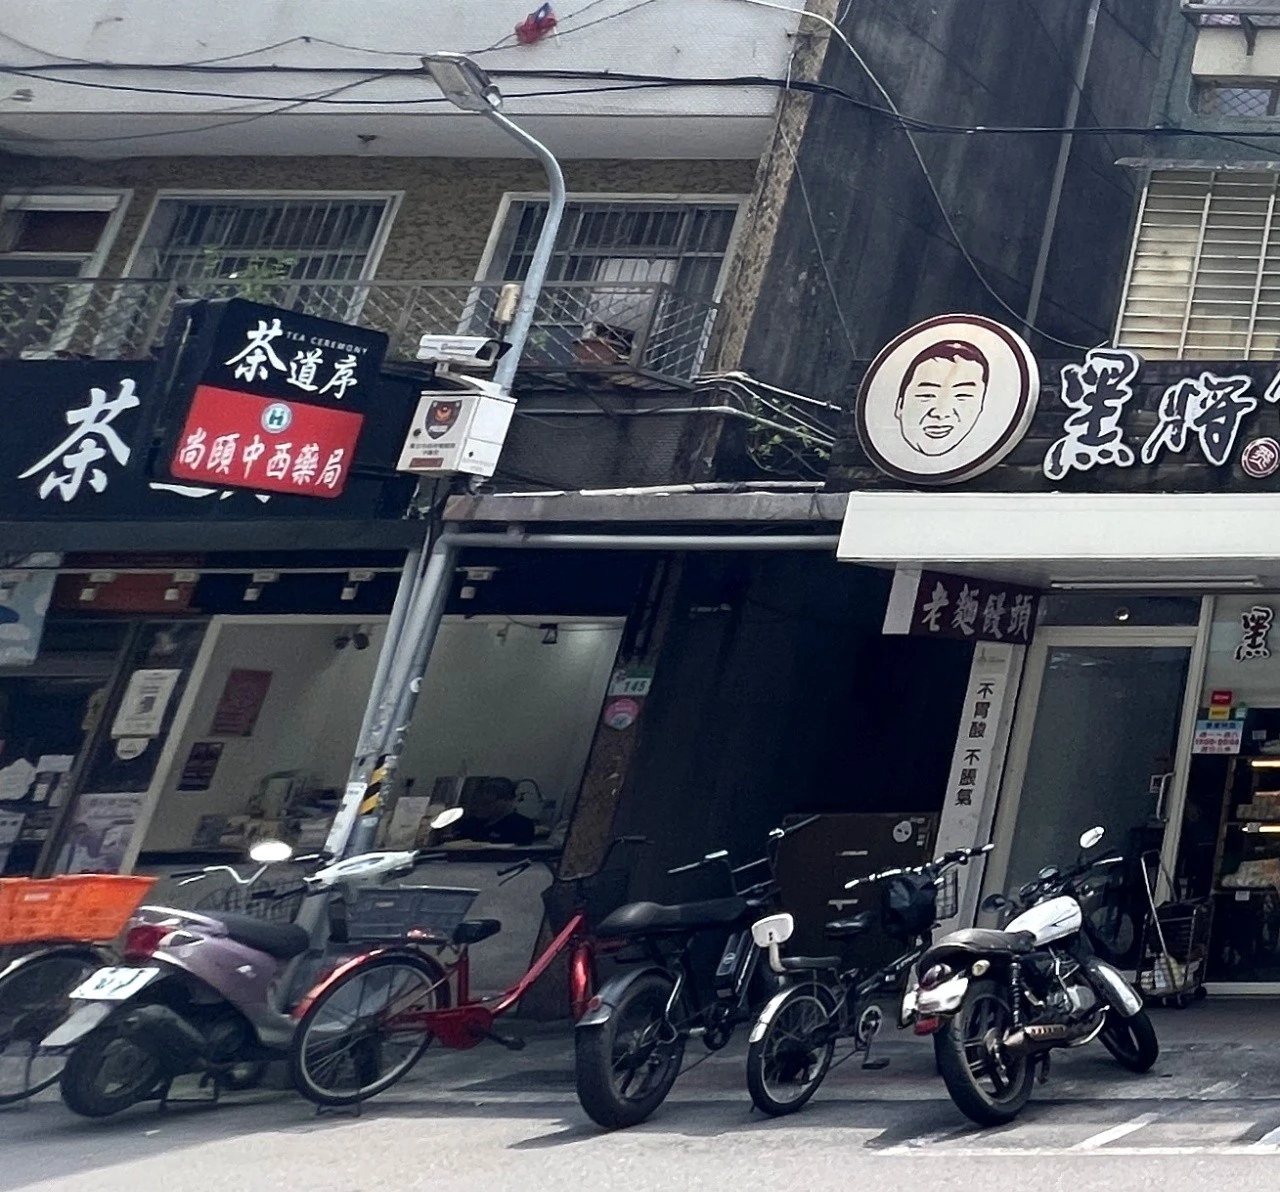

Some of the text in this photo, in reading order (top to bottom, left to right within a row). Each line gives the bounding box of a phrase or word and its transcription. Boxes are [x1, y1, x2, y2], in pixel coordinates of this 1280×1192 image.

[224, 318, 359, 399] 茶道序
[286, 331, 368, 354] TEA CEREMONY
[179, 427, 346, 489] 尚頤中西藥局
[955, 682, 995, 806] 不胃酸 不脹氣
